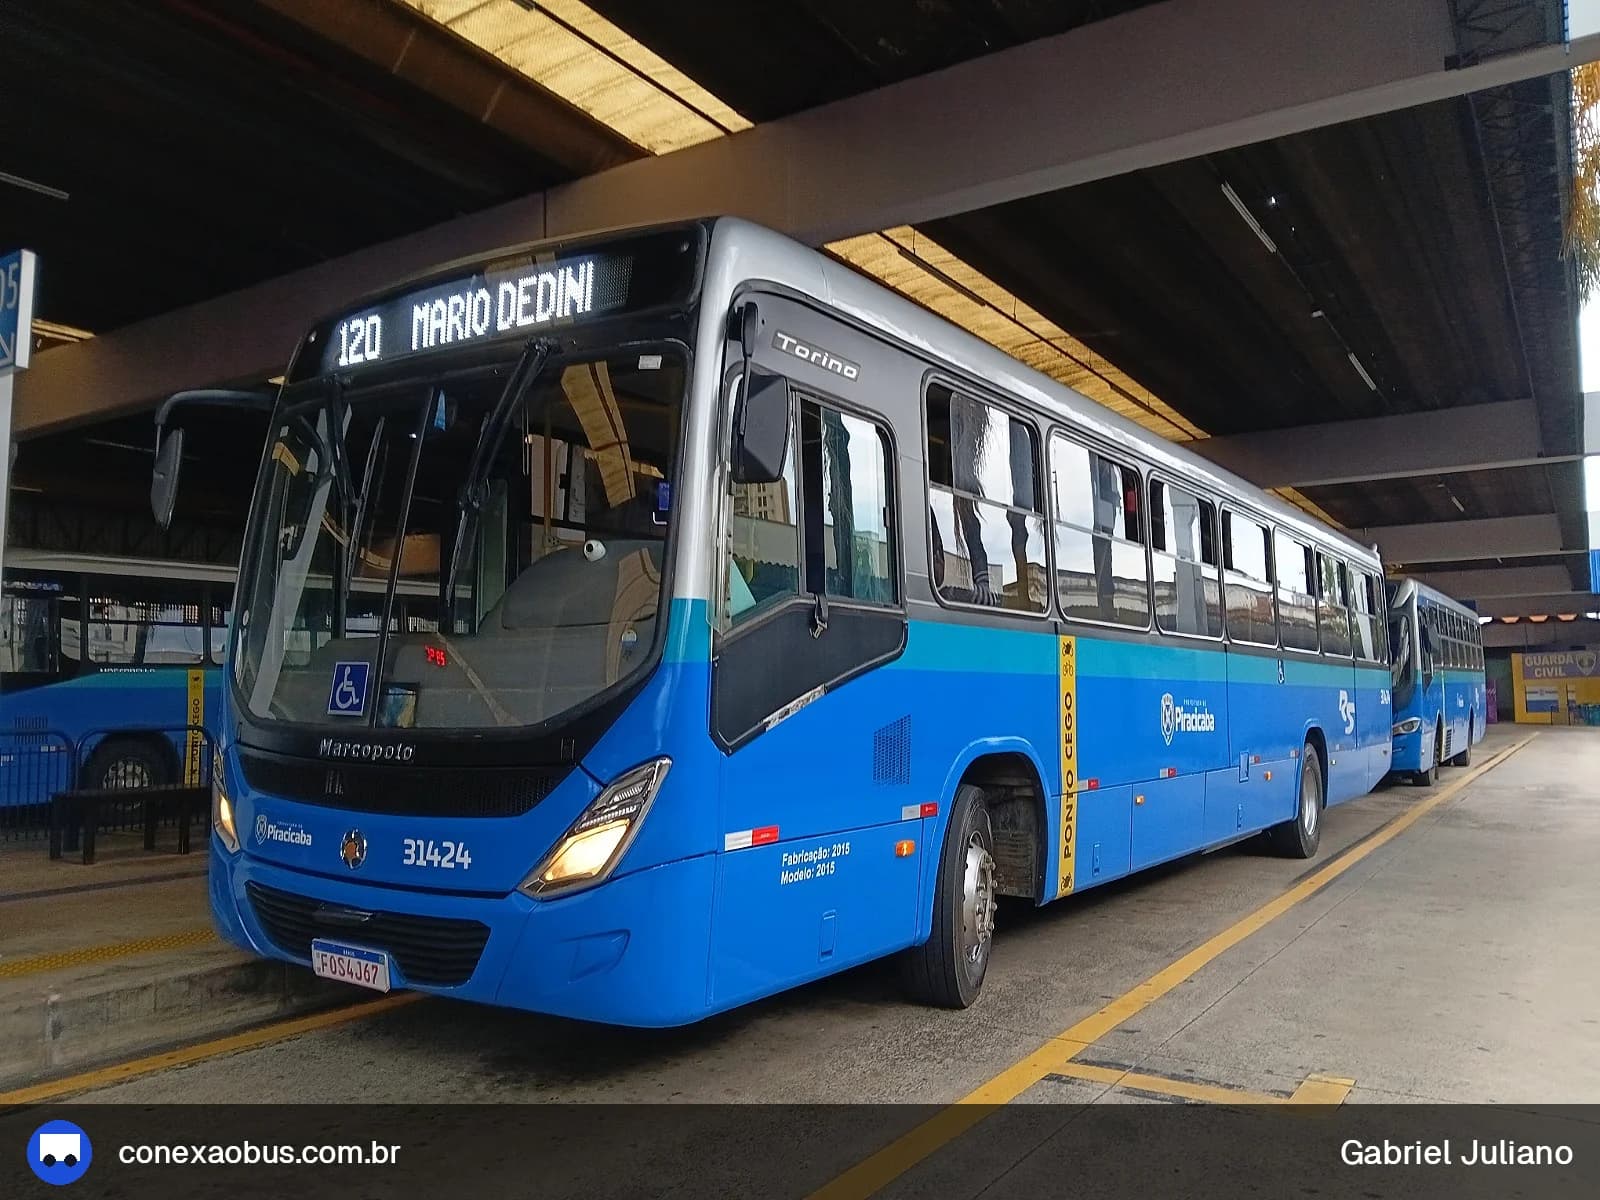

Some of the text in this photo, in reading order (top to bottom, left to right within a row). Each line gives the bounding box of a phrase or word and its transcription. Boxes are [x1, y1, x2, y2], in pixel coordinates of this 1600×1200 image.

[338, 261, 595, 366] 120 MARIO DEDINI
[777, 332, 858, 379] Torino
[1524, 653, 1575, 667] GUARDA
[1534, 666, 1567, 678] CIVIL
[1175, 705, 1215, 732] Piracicaba
[320, 738, 414, 761] Marcopolo
[1063, 691, 1075, 859] PONTO CEGO
[267, 824, 312, 846] Piracicaba
[403, 838, 472, 870] 31424
[781, 841, 851, 867] Fabricação: 2015
[780, 860, 836, 885] Modelo: 2015
[320, 953, 379, 985] FOS4J67
